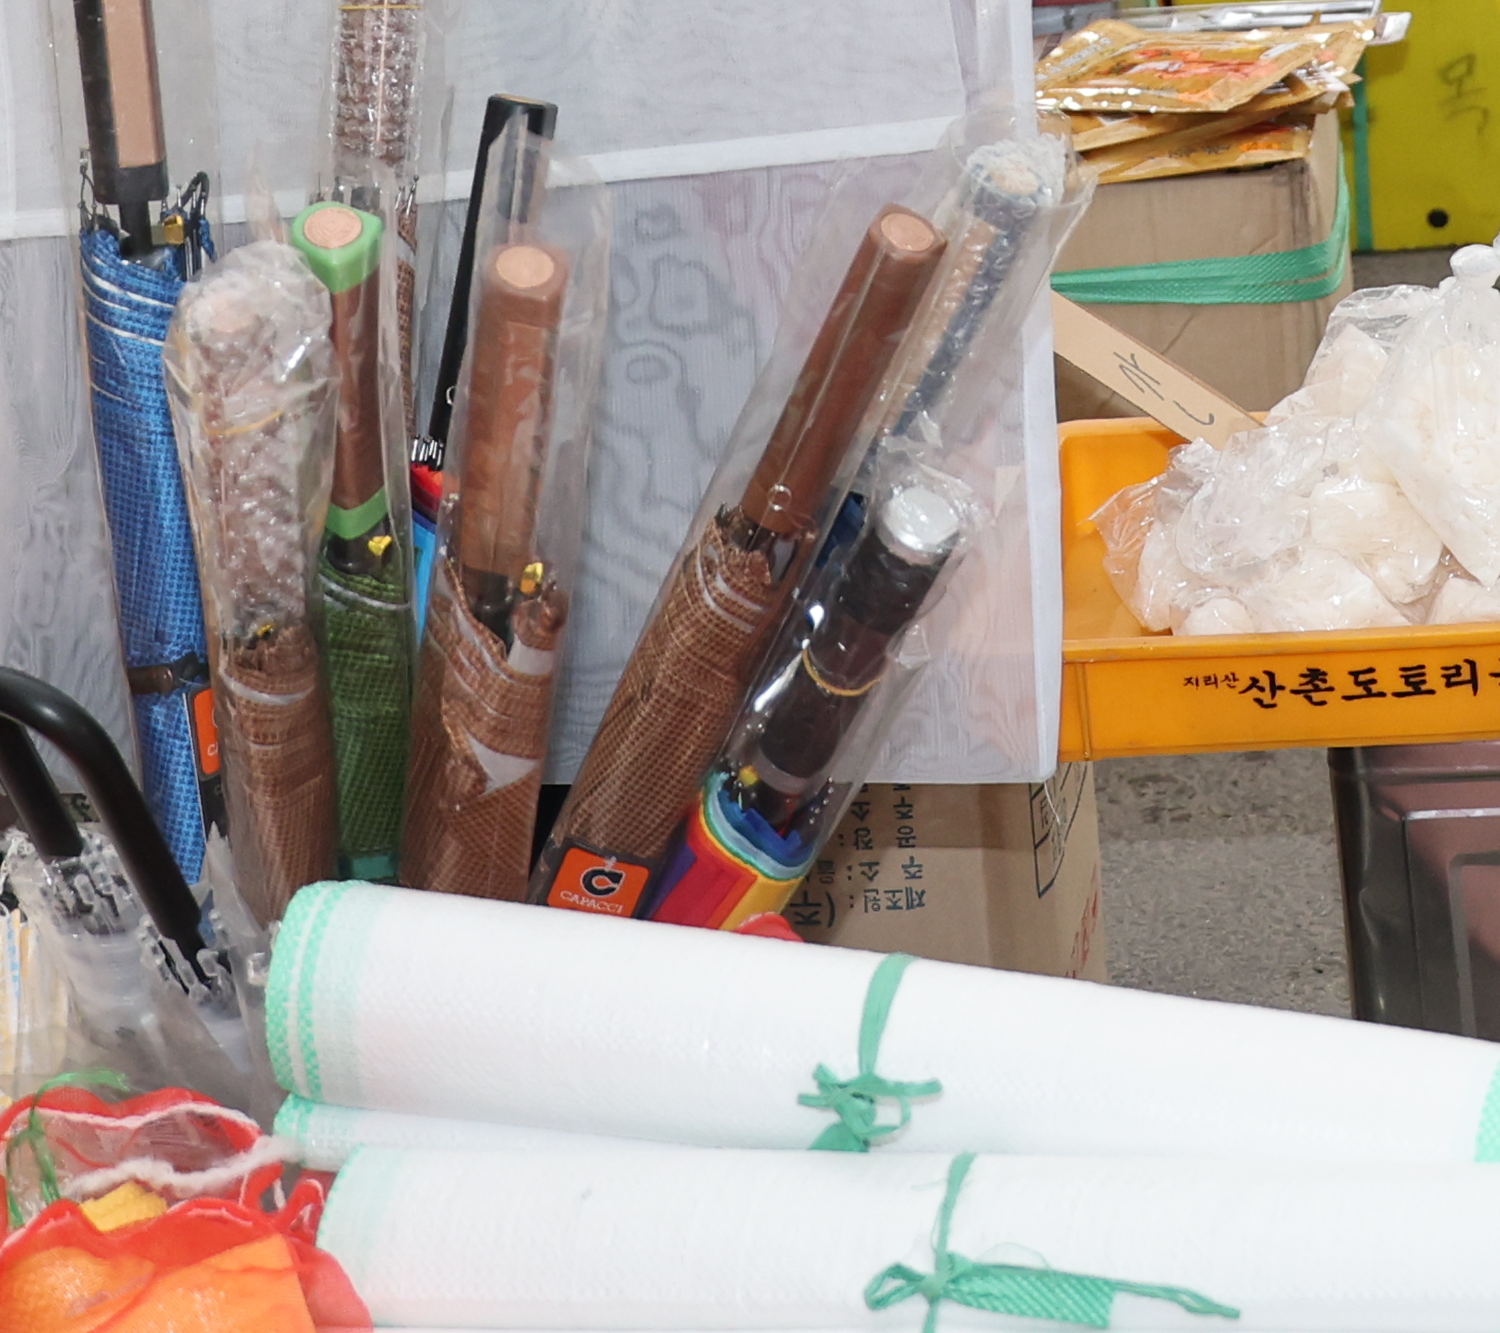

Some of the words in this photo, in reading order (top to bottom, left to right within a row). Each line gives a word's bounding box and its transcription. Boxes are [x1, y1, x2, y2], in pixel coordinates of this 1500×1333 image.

[1183, 672, 1240, 691] 지리산
[560, 890, 624, 913] CAPACCI
[863, 887, 926, 913] 제조원
